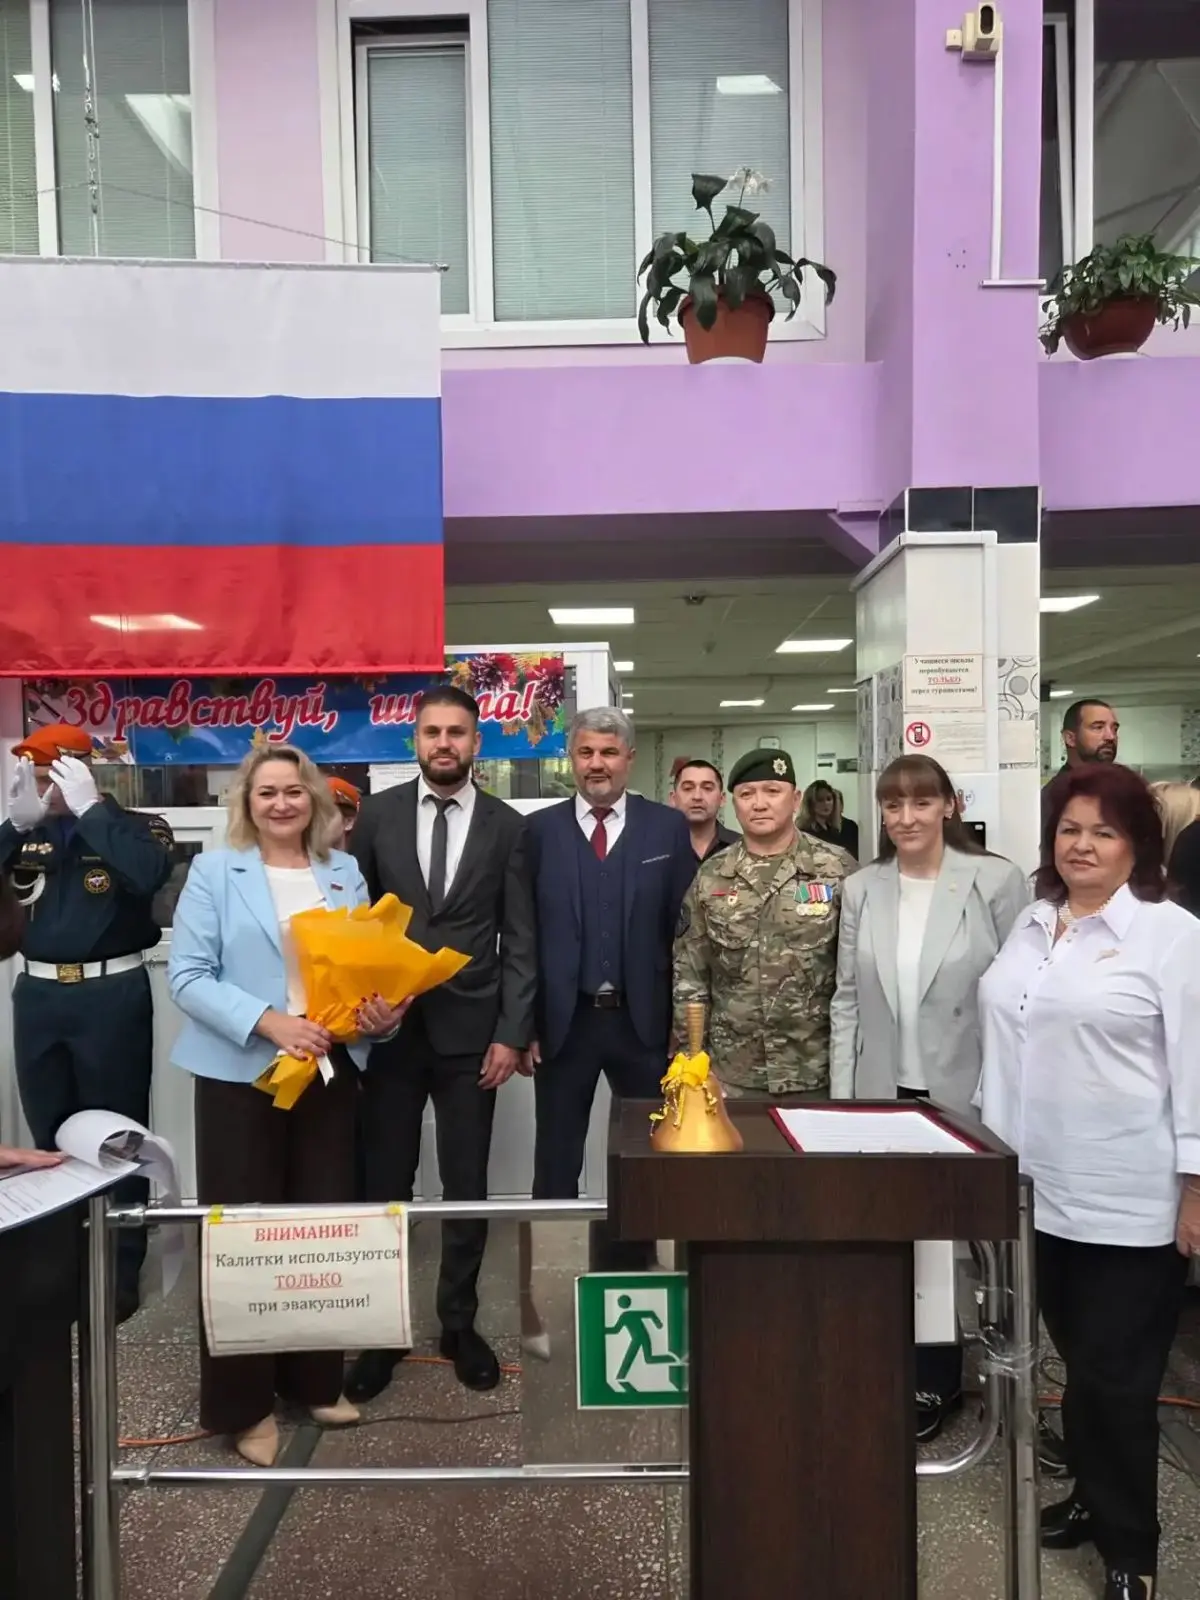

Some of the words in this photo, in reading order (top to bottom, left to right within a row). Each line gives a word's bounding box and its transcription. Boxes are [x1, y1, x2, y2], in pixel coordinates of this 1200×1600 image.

[928, 676, 961, 685] ТОЛЬКО
[58, 679, 338, 742] Здравствуй,
[254, 1224, 360, 1242] ВНИМАНИЕ!
[215, 1253, 284, 1268] Калитки
[287, 1248, 401, 1265] используются
[274, 1272, 344, 1291] ТОЛЬКО
[248, 1301, 278, 1316] при
[281, 1294, 371, 1313] эвакуации!
